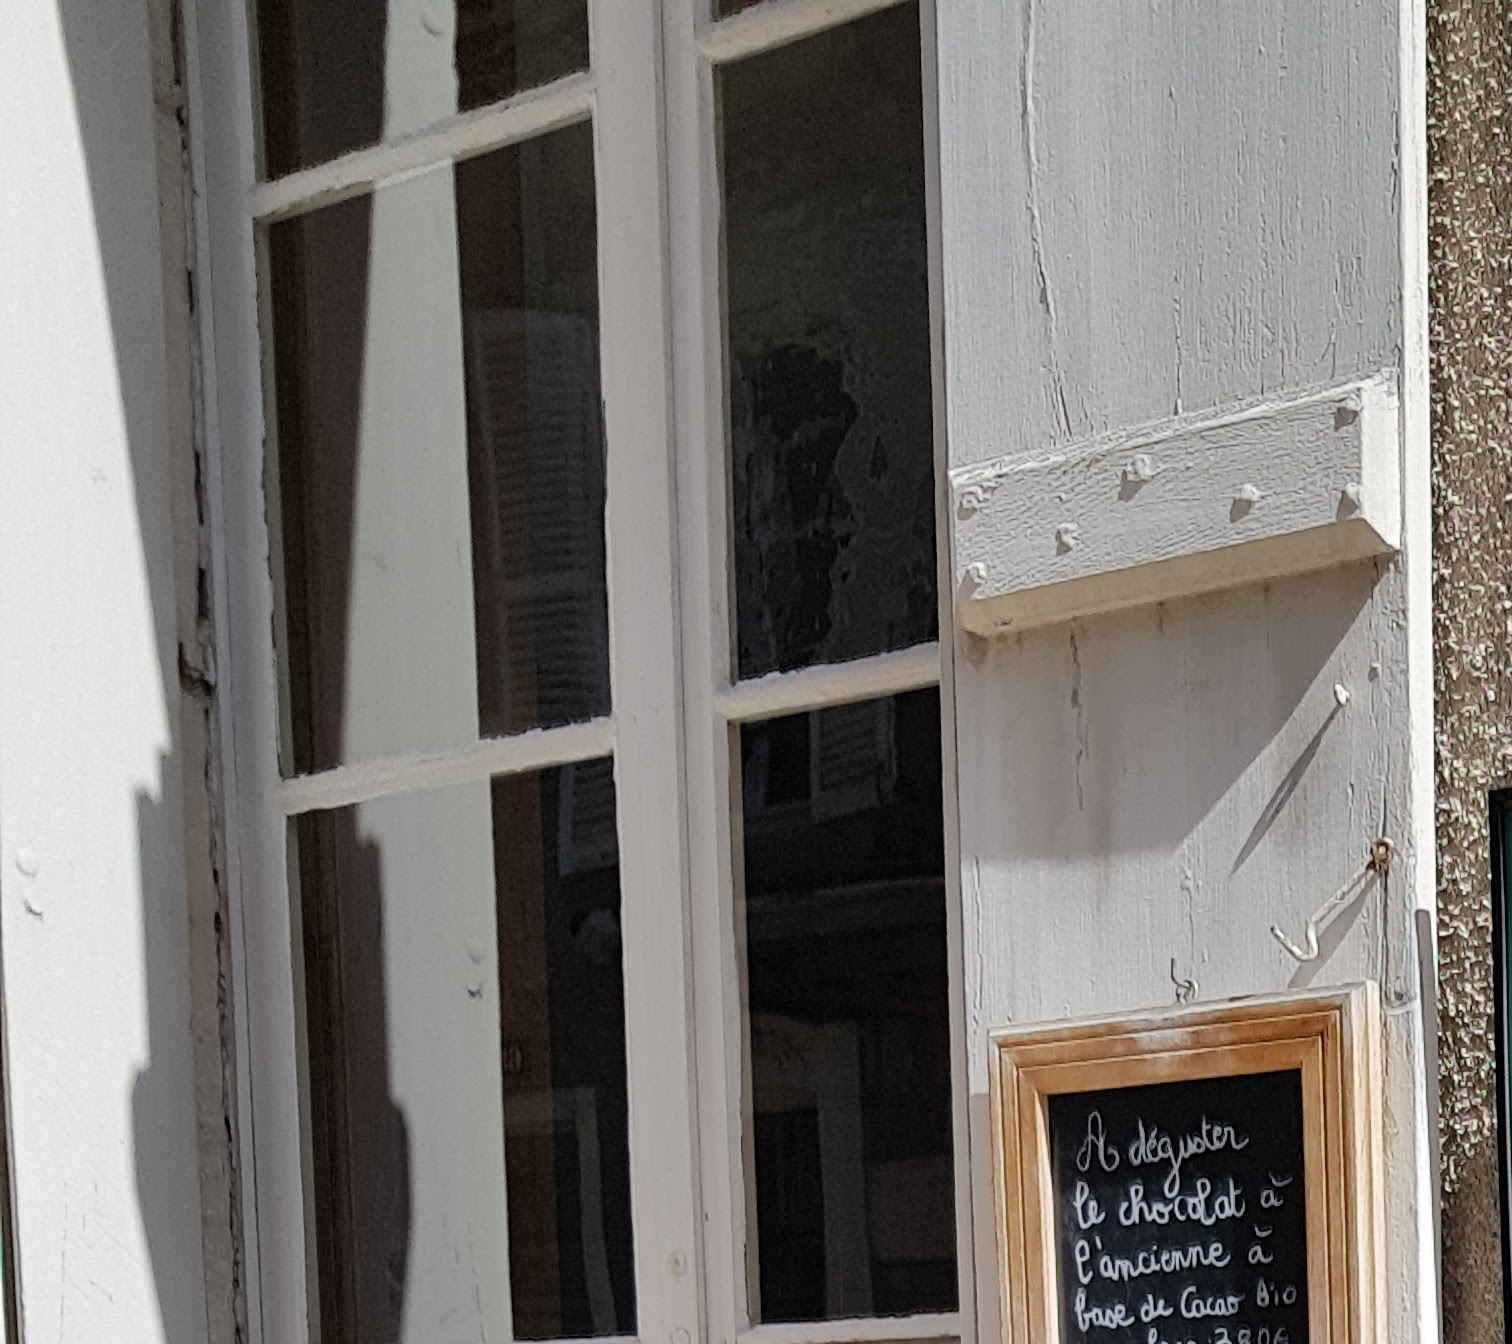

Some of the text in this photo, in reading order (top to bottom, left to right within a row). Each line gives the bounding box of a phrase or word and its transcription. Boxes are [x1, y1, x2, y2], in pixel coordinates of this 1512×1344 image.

[1128, 1114, 1249, 1198] déguster
[1119, 1177, 1246, 1226] chocolat
[1260, 1172, 1293, 1209] à
[1075, 1223, 1273, 1285] l'ancienne à
[1074, 1286, 1135, 1332] base
[1140, 1294, 1174, 1323] de
